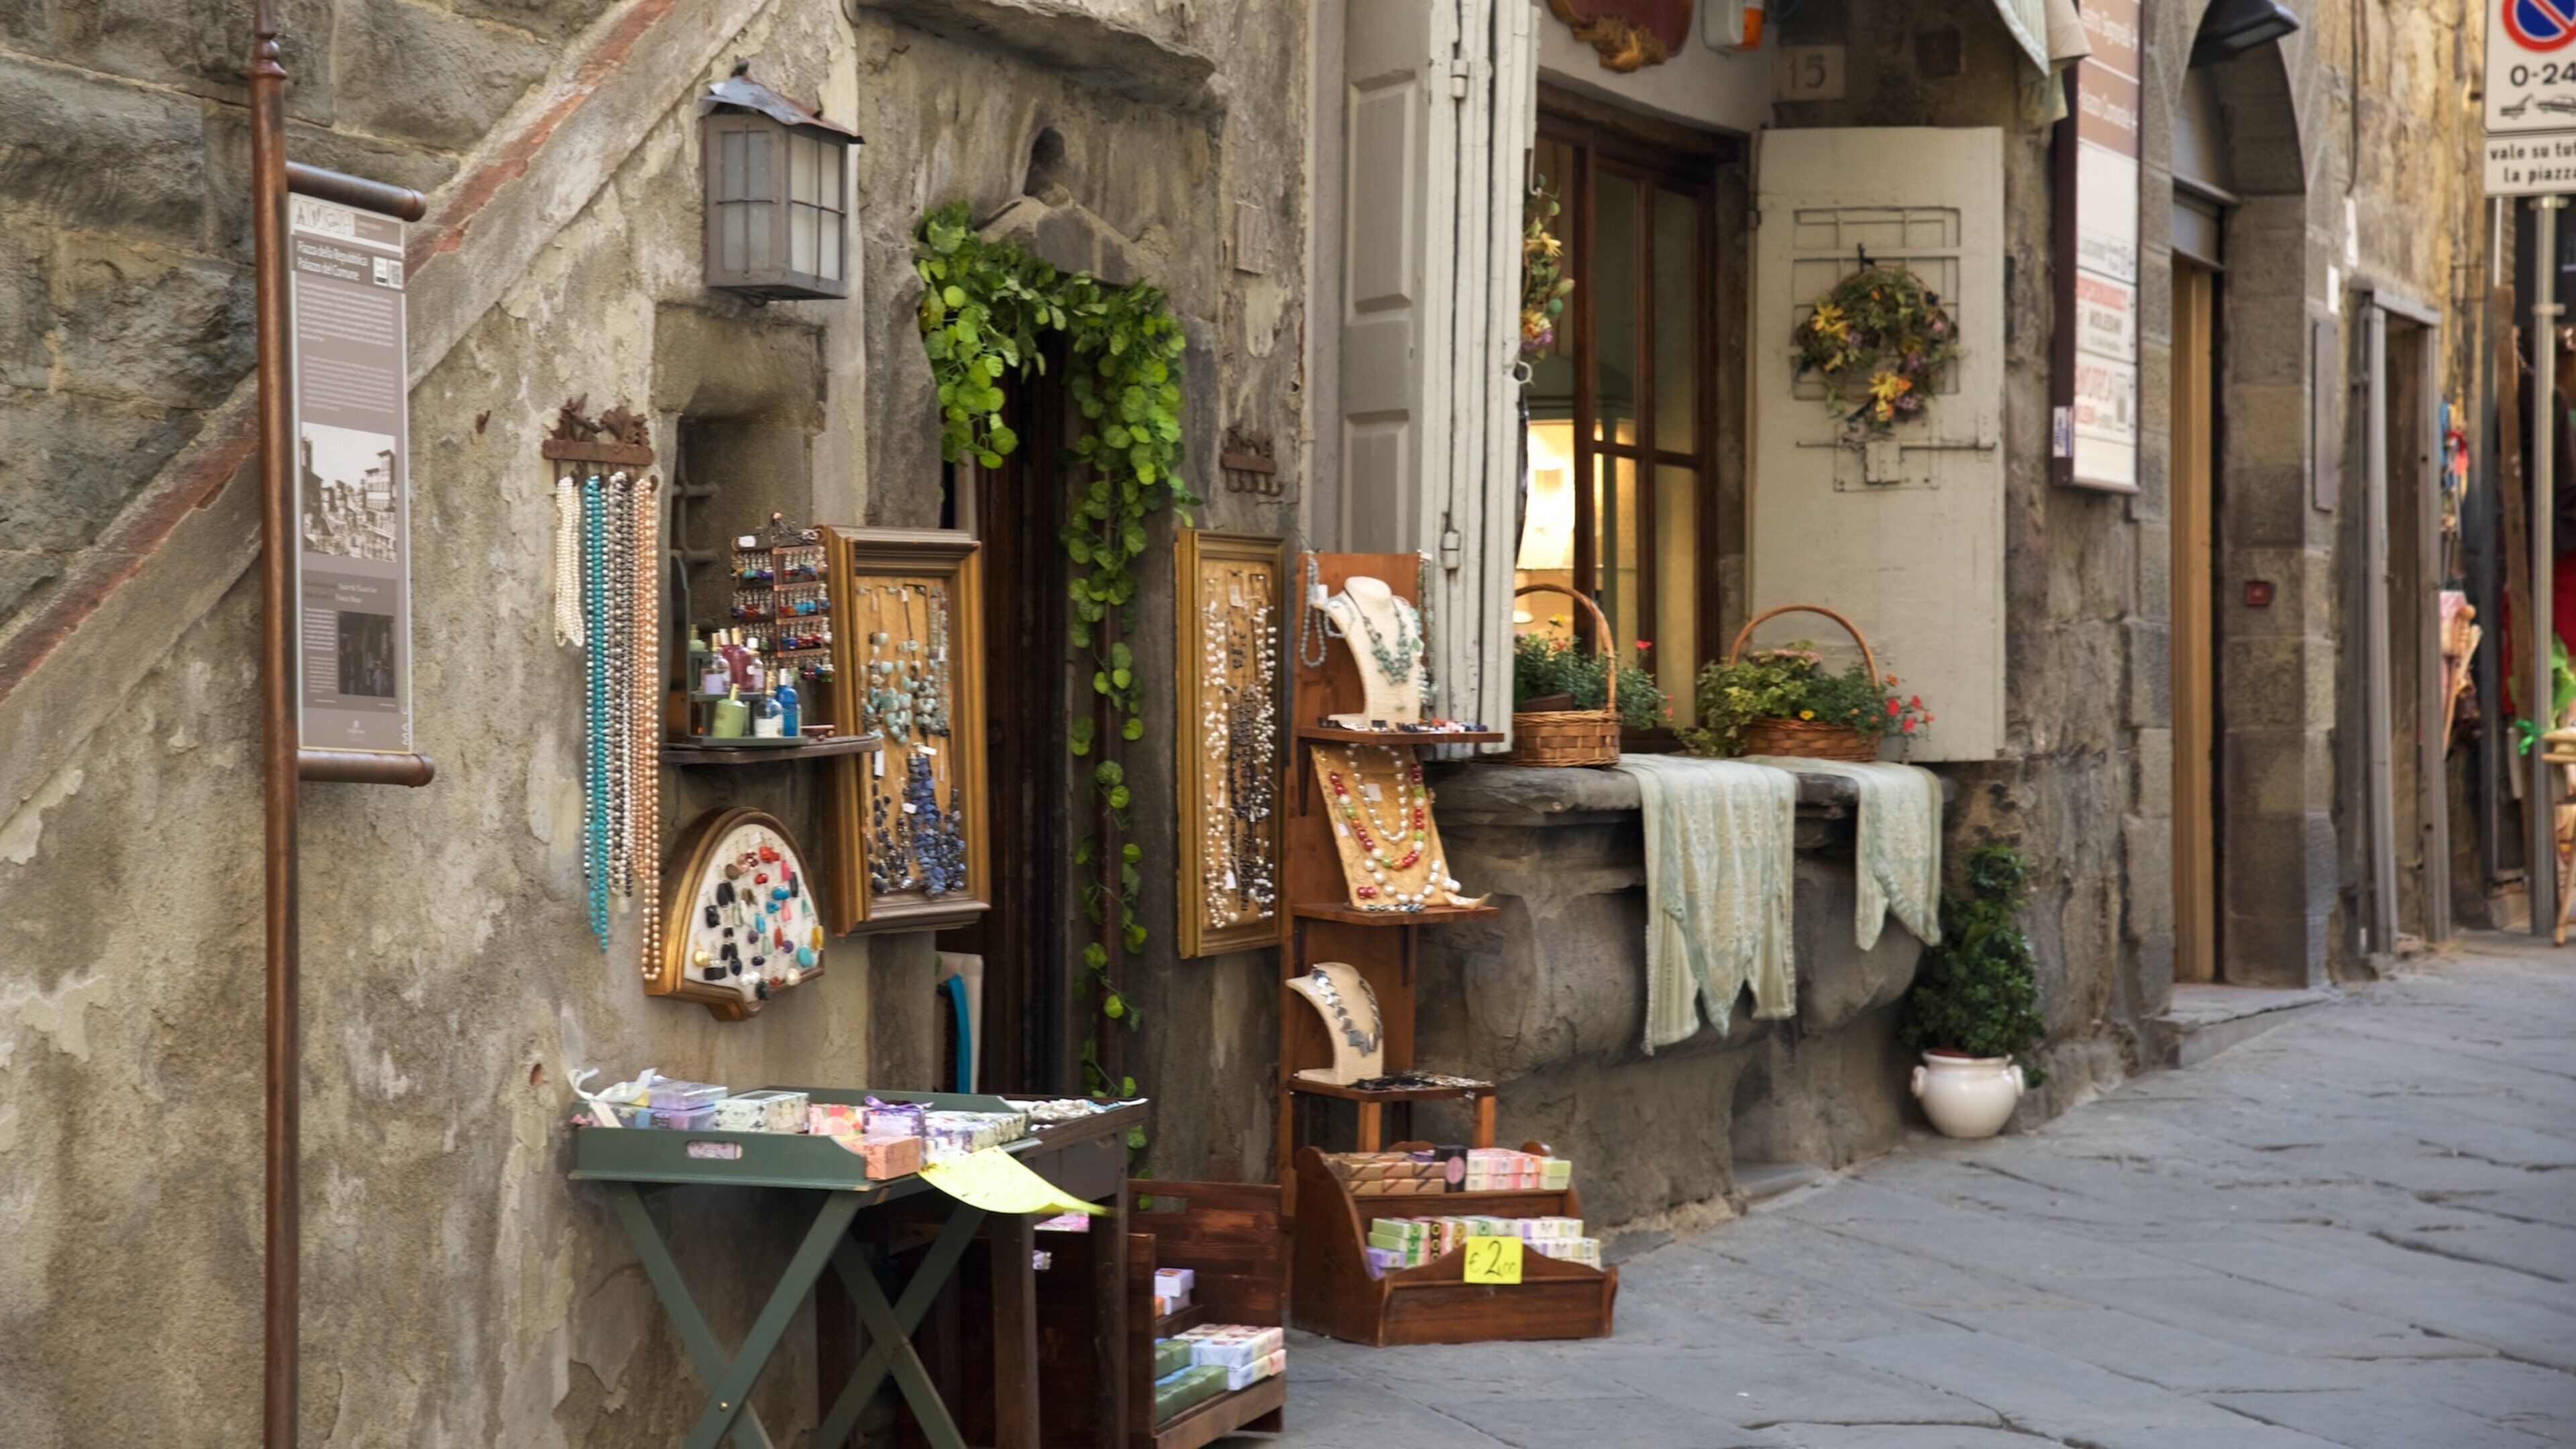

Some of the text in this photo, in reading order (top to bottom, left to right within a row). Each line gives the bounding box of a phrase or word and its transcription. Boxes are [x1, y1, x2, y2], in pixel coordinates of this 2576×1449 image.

[1788, 54, 1826, 90] 15
[2510, 62, 2576, 87] 0-24
[2490, 144, 2525, 160] vale
[2532, 146, 2550, 159] su
[2504, 167, 2520, 183] la
